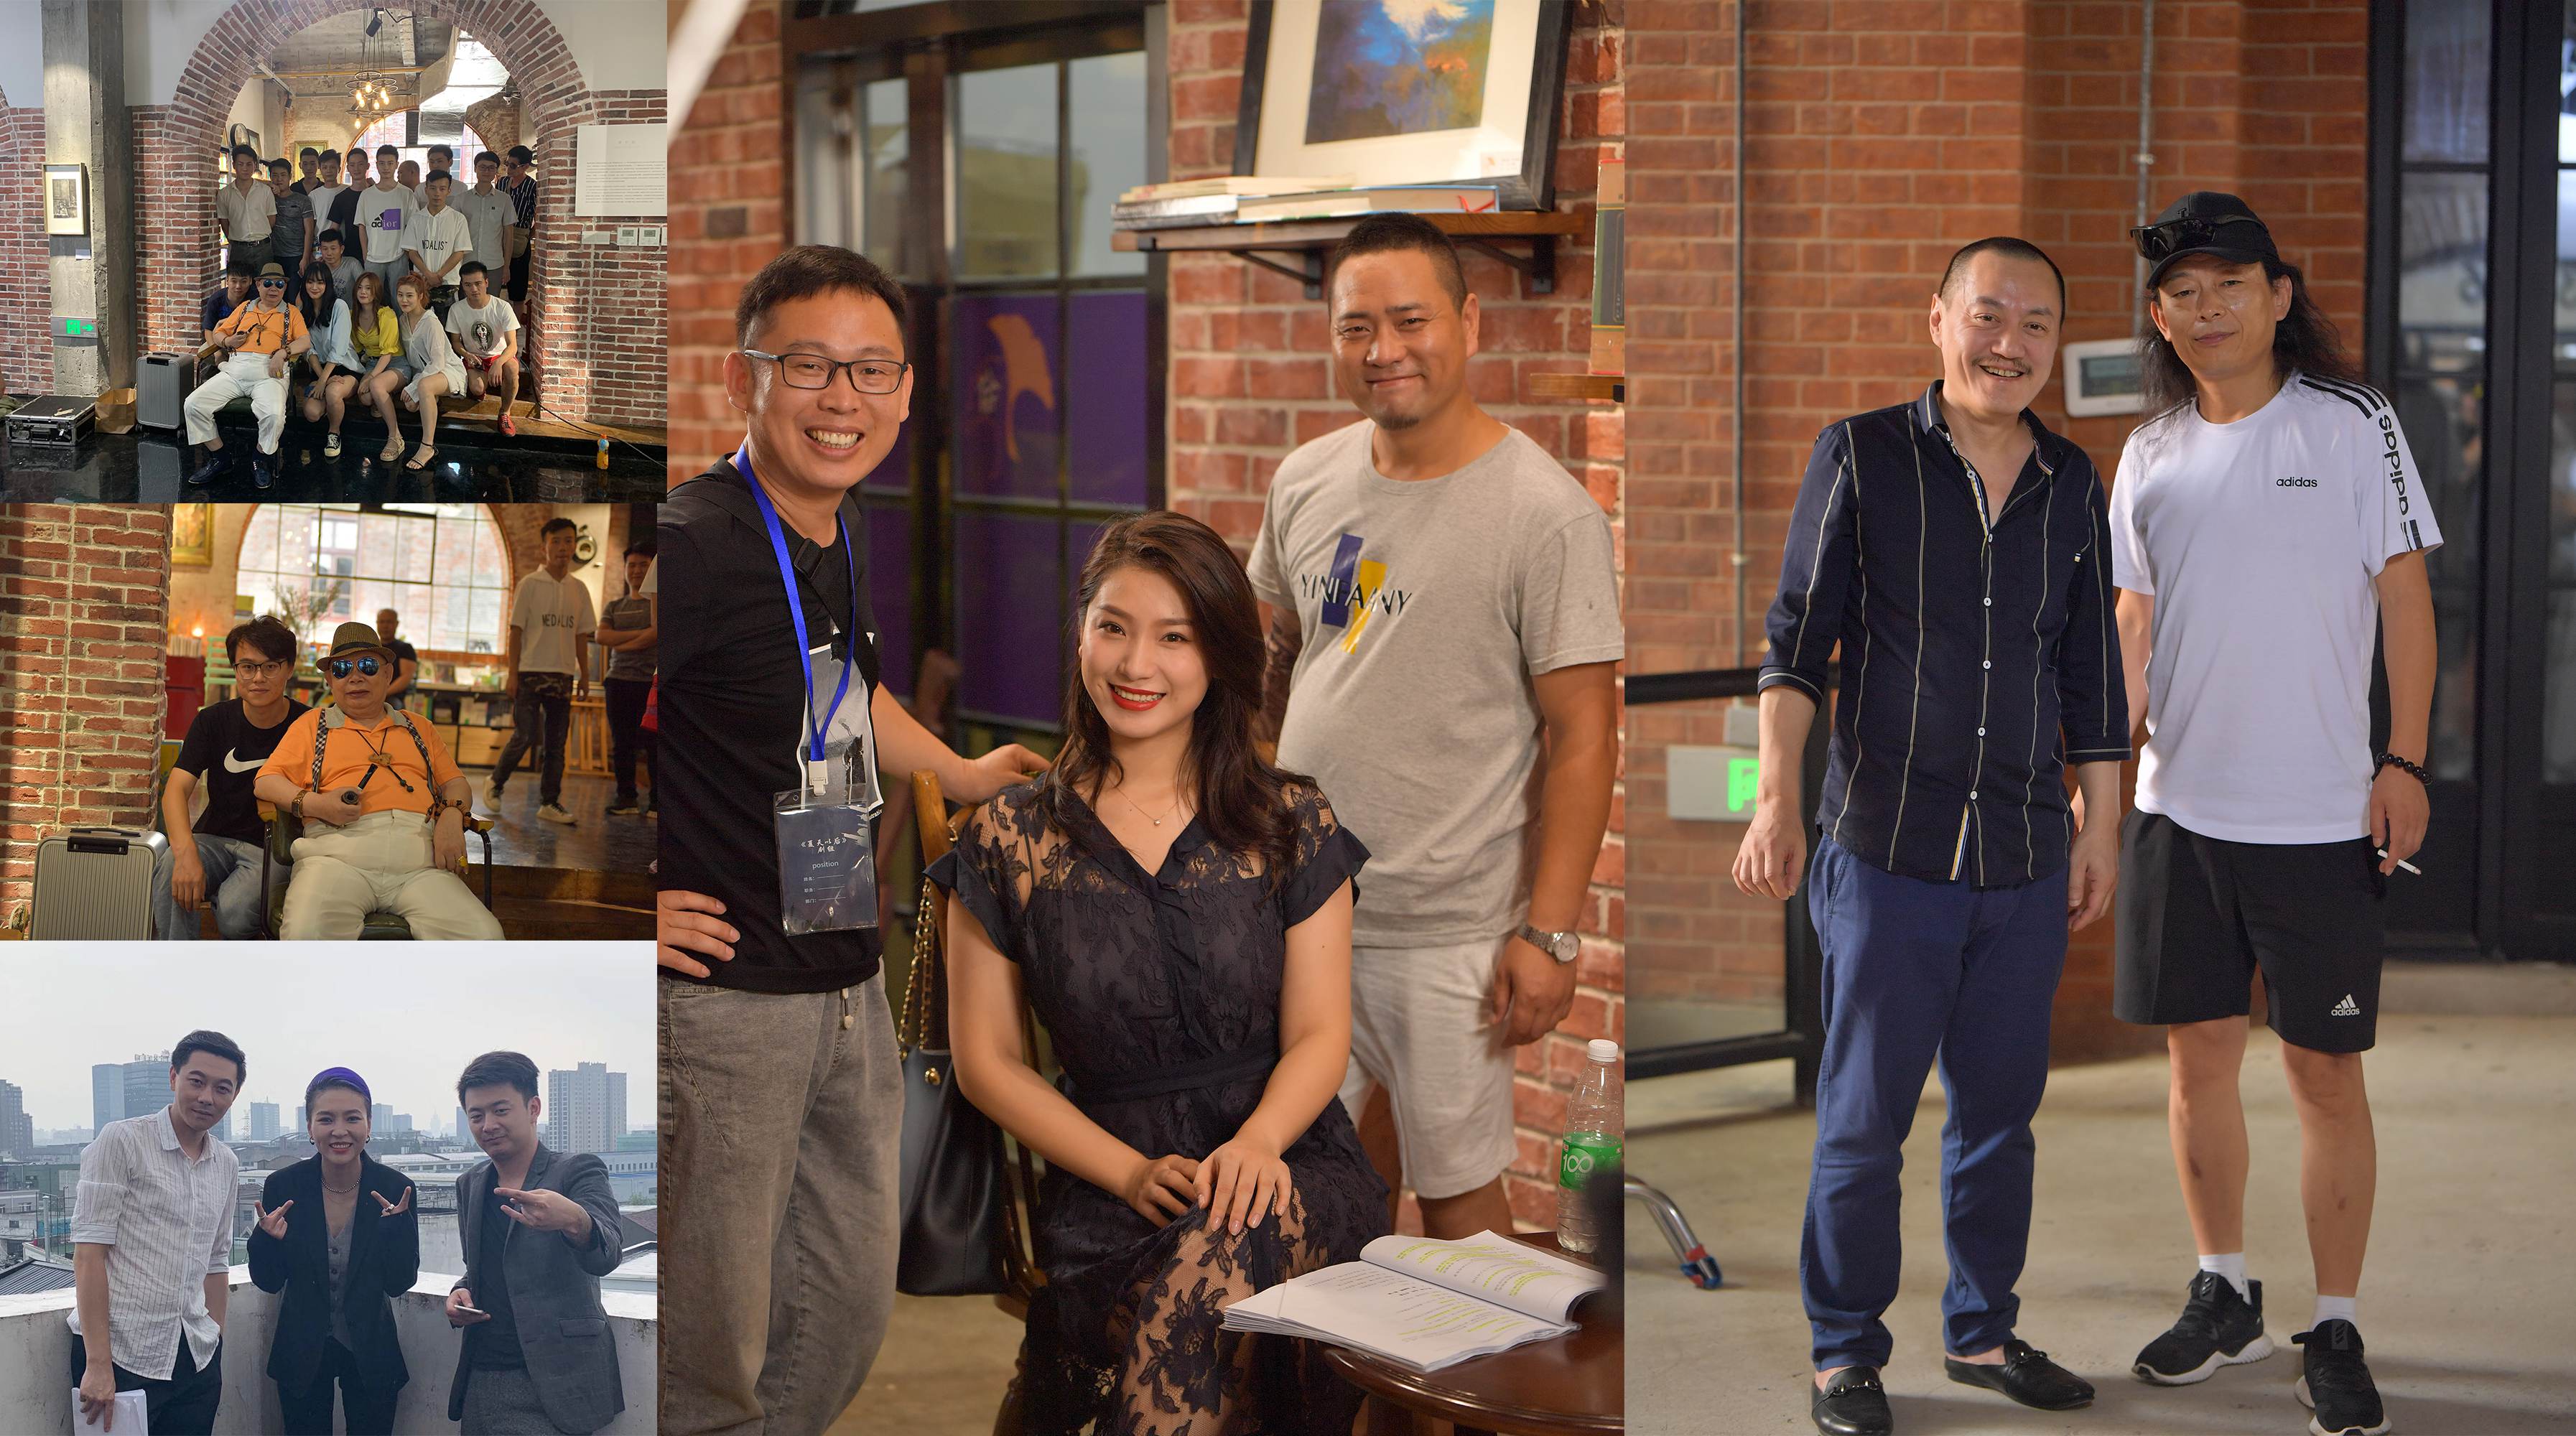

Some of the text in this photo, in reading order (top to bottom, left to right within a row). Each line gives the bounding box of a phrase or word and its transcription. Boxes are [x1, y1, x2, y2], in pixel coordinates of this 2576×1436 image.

[2379, 414, 2409, 516] adidas
[2276, 476, 2318, 488] adidas
[812, 861, 839, 869] position
